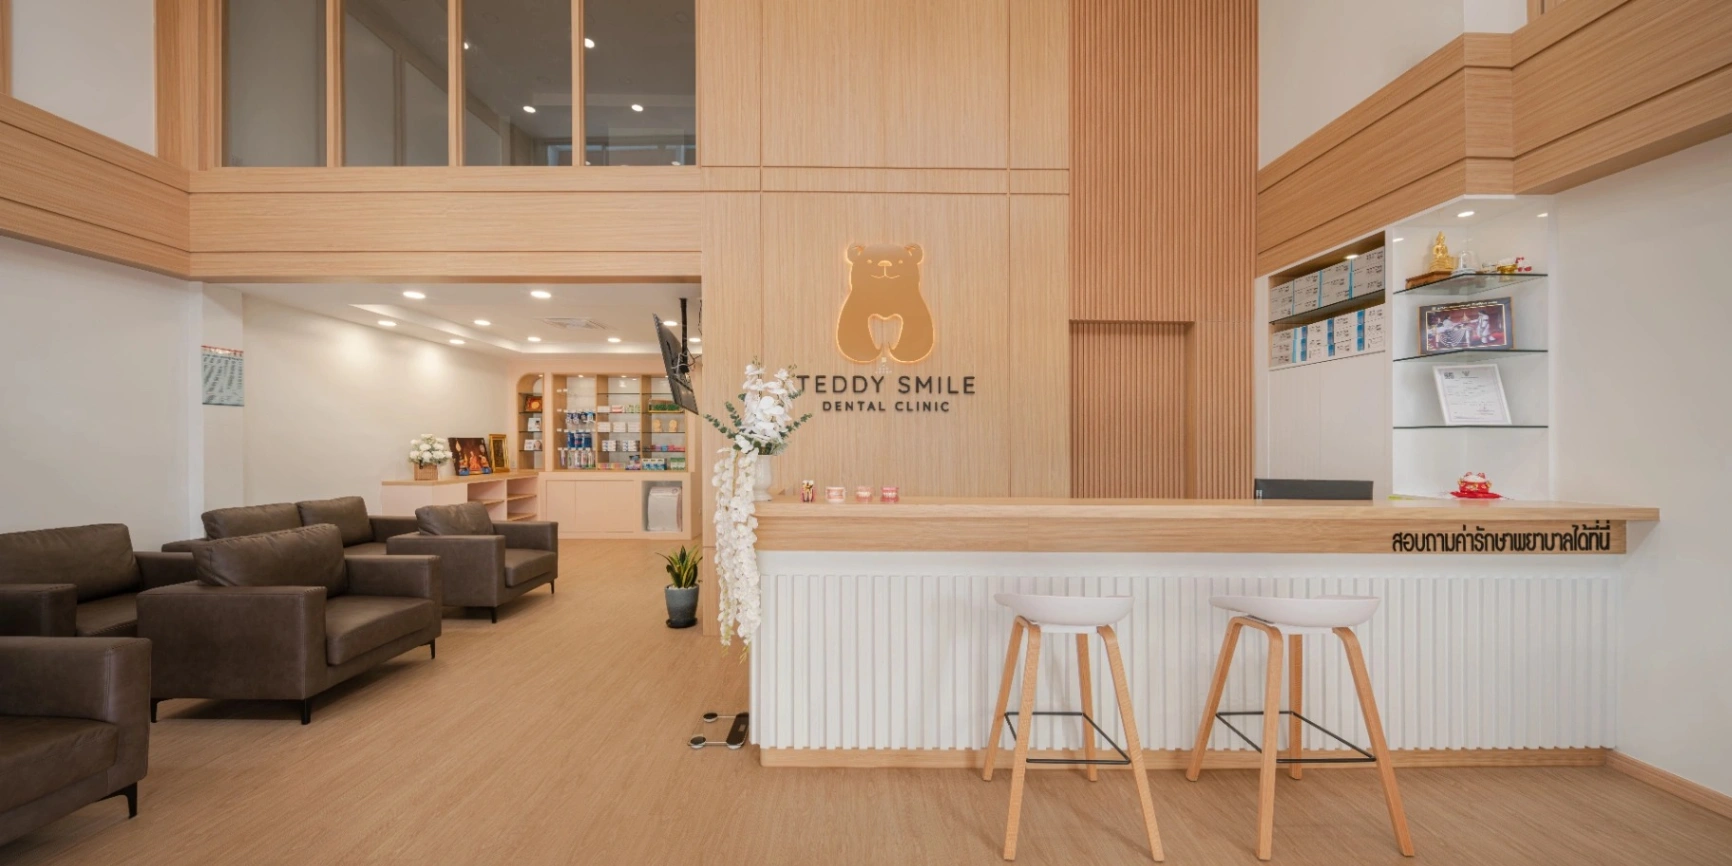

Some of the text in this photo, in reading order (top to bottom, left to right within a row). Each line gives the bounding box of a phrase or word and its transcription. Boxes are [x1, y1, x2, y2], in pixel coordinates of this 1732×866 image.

[796, 375, 976, 394] TEDDY SMILE
[822, 401, 950, 412] DENTAL CLINIC
[1392, 519, 1611, 552] สอบถามค่ารักษาพยาบาลได้ที่นี่
